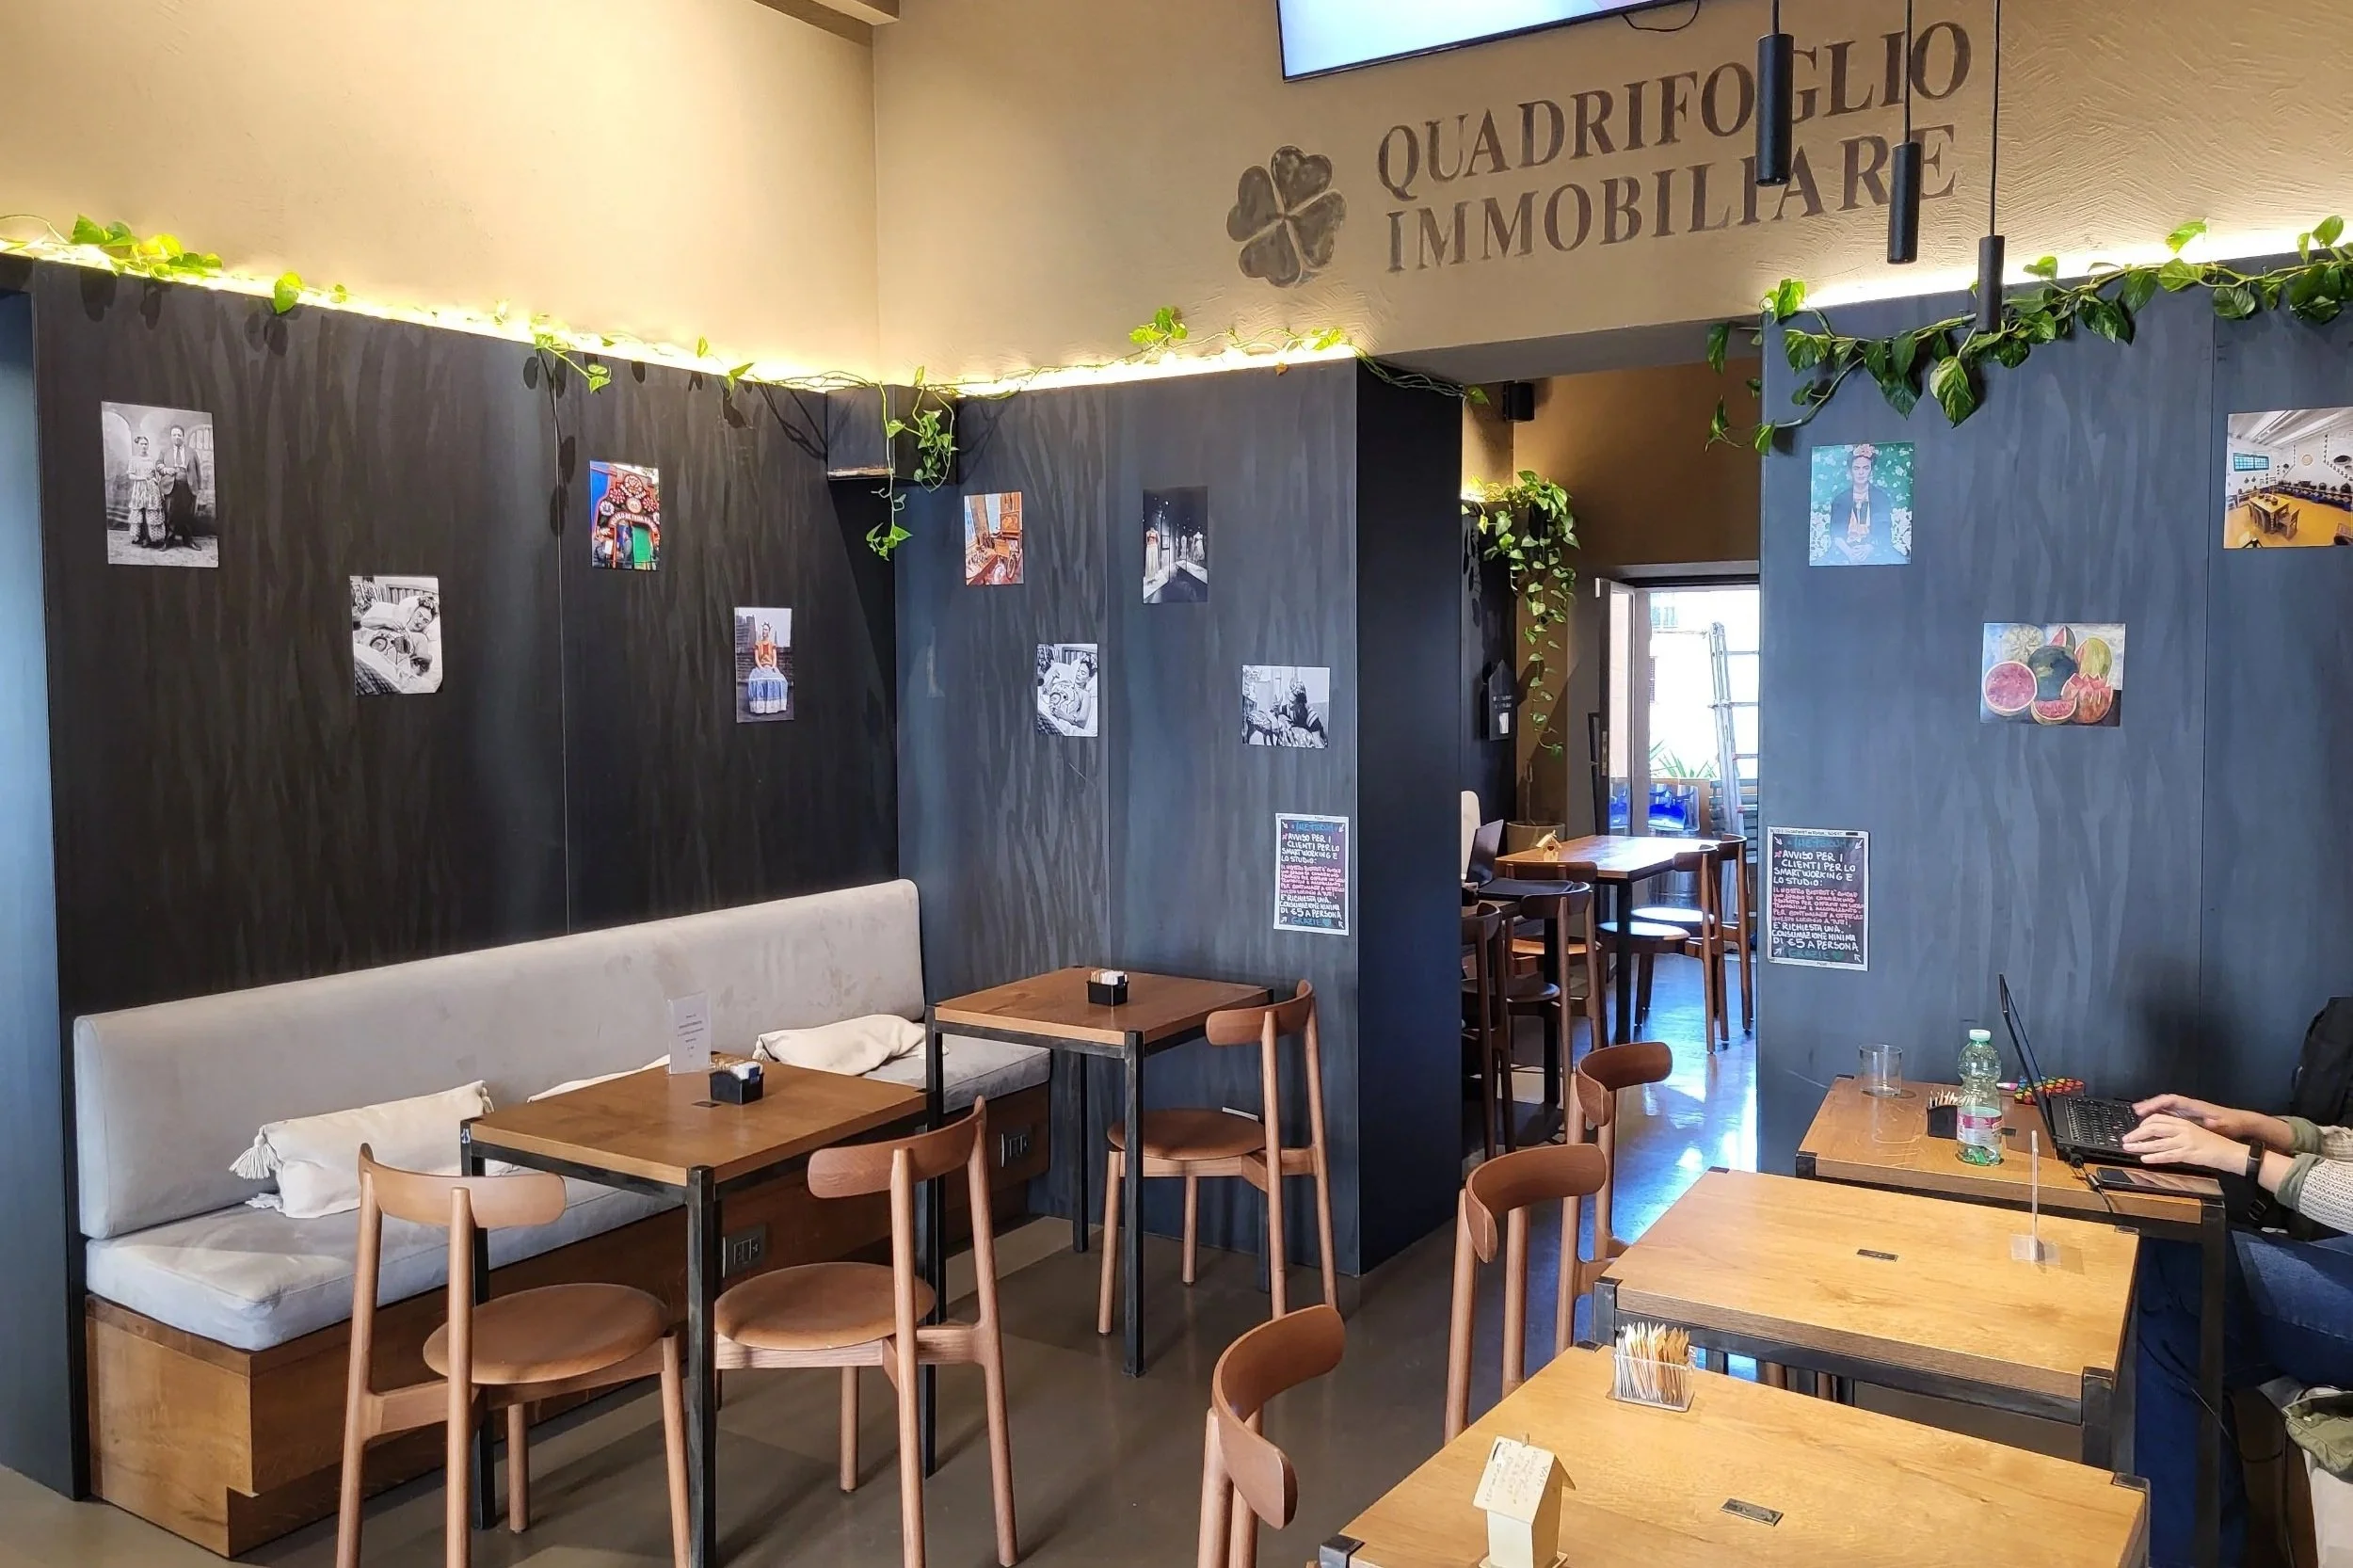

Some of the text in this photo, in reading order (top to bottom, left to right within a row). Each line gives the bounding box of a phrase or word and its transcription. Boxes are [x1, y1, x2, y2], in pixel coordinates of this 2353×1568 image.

[1385, 123, 1957, 273] IMMOBILIARE
[1289, 833, 1310, 841] AVVISO
[1311, 834, 1325, 842] PER
[1287, 841, 1315, 850] CLIENTI
[1317, 843, 1331, 852] PER
[1783, 850, 1813, 859] AVVISO
[1817, 852, 1835, 861] PER
[1782, 859, 1820, 870] CLIENTI
[1312, 909, 1341, 920] PERSONA
[1782, 923, 1823, 932] RICHIESTA
[1786, 939, 1805, 948] €5
[1817, 940, 1859, 952] PERSONA
